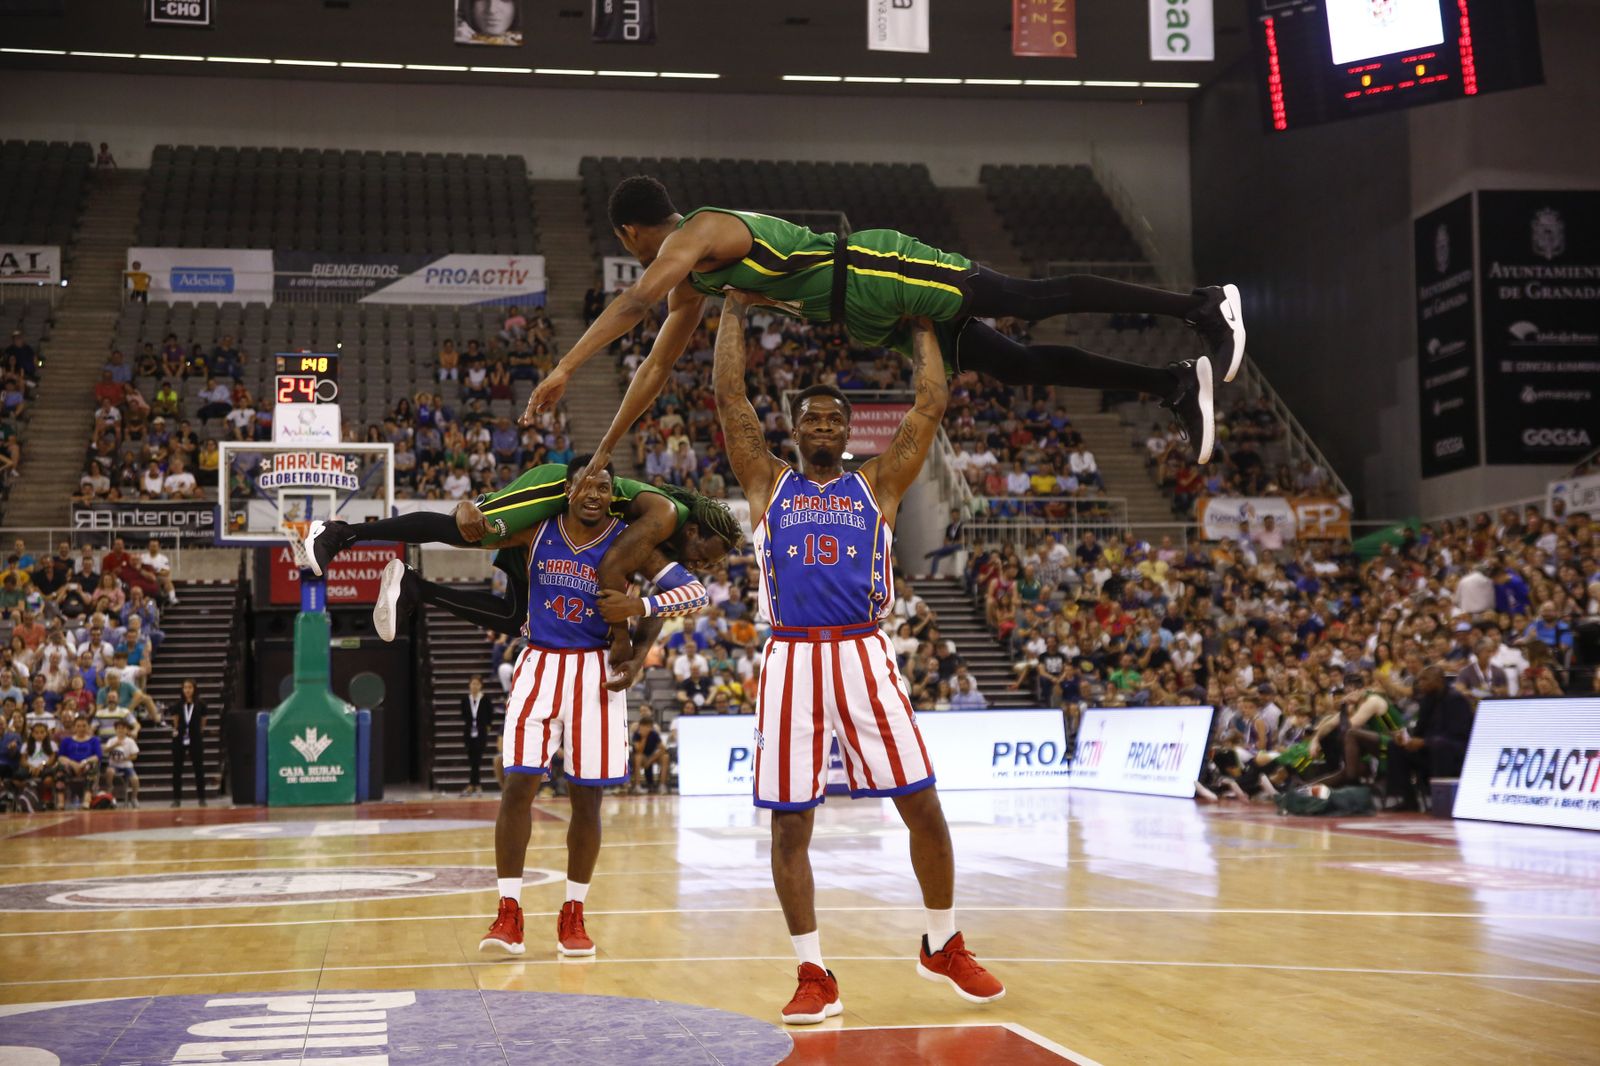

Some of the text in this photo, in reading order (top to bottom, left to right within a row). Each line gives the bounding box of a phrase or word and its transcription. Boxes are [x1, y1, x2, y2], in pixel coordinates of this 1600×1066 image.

[312, 264, 399, 277] BIENVENIDOS
[425, 267, 529, 285] PROACTIV
[278, 378, 315, 402] 24
[274, 453, 345, 474] HARLEM
[260, 470, 358, 490] GLOBETROTTERS
[792, 493, 854, 513] HARLEM
[780, 509, 866, 531] GLOBETROTTERS
[803, 533, 840, 566] 19
[546, 558, 598, 583] HARLEM
[551, 595, 584, 624] 42
[1126, 742, 1188, 772] PROACTIV
[279, 765, 345, 777] CAJA RURAL
